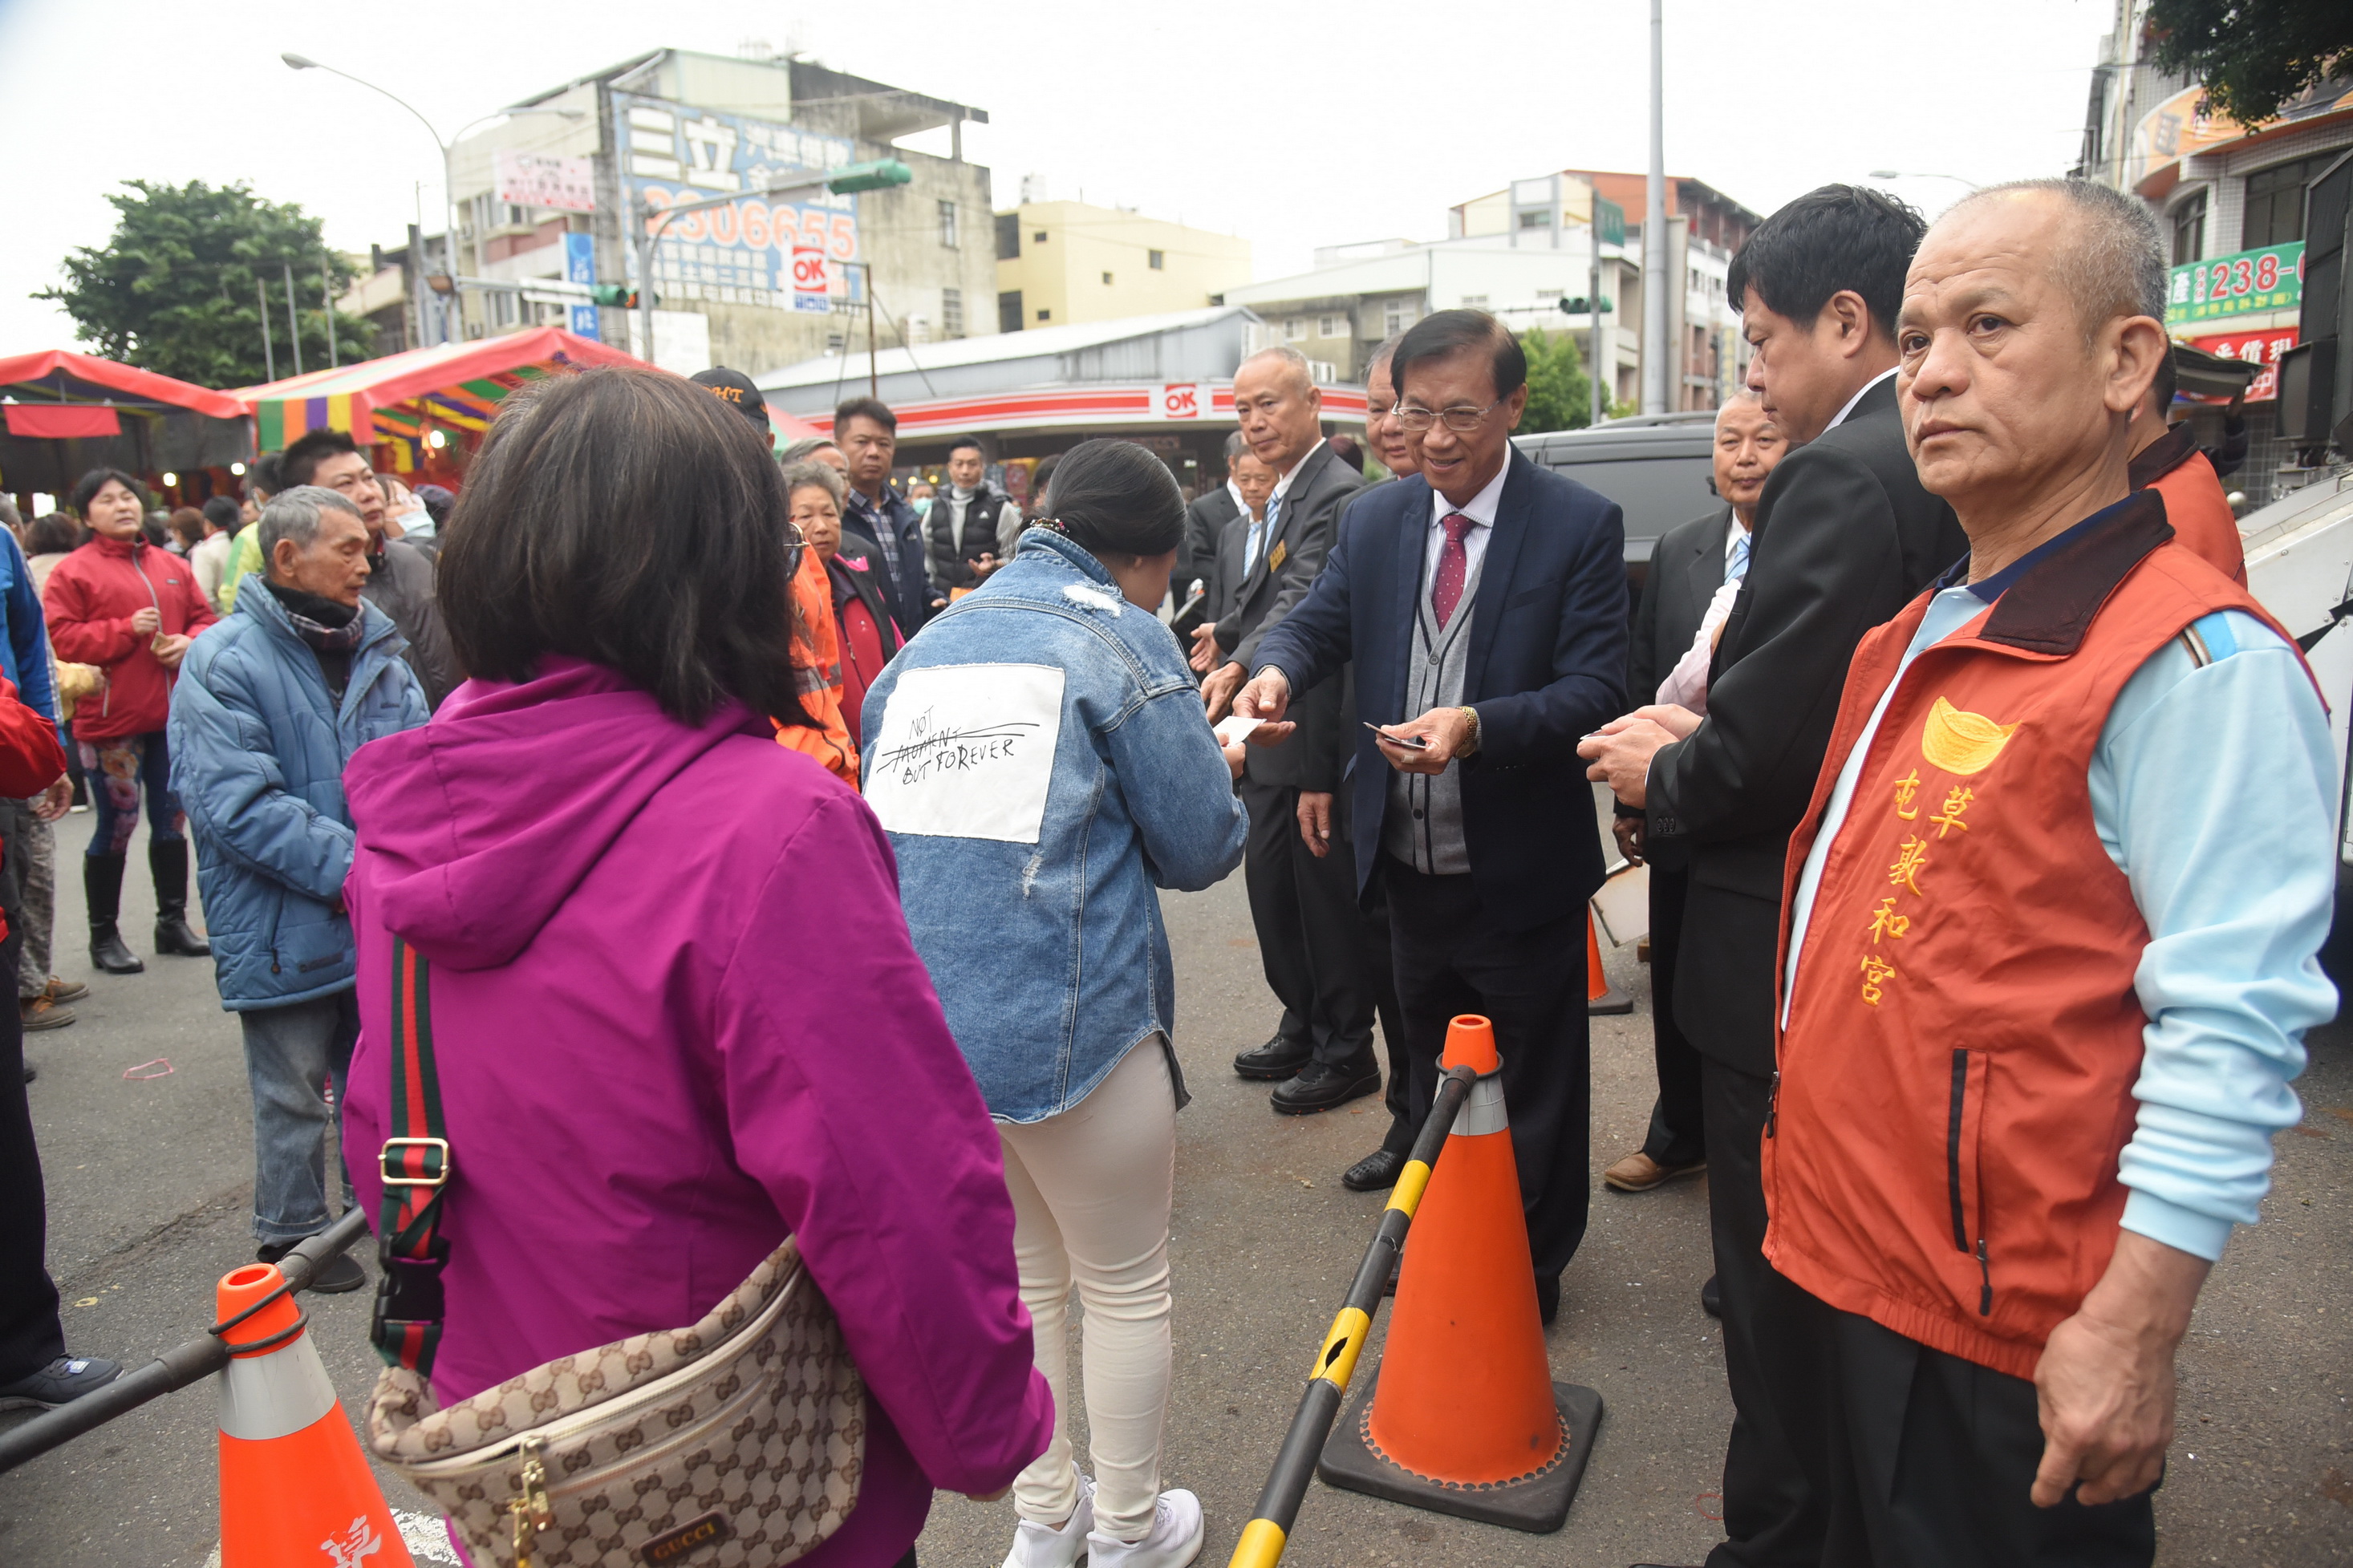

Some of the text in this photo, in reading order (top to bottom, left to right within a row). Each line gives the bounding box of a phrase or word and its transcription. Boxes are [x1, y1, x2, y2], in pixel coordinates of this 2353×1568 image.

[628, 106, 740, 192] 三立
[793, 257, 826, 282] OK
[1166, 391, 1197, 411] OK
[909, 705, 934, 739] NOT
[903, 739, 1014, 785] BUT FOREVER
[654, 1521, 716, 1561] GUCCI
